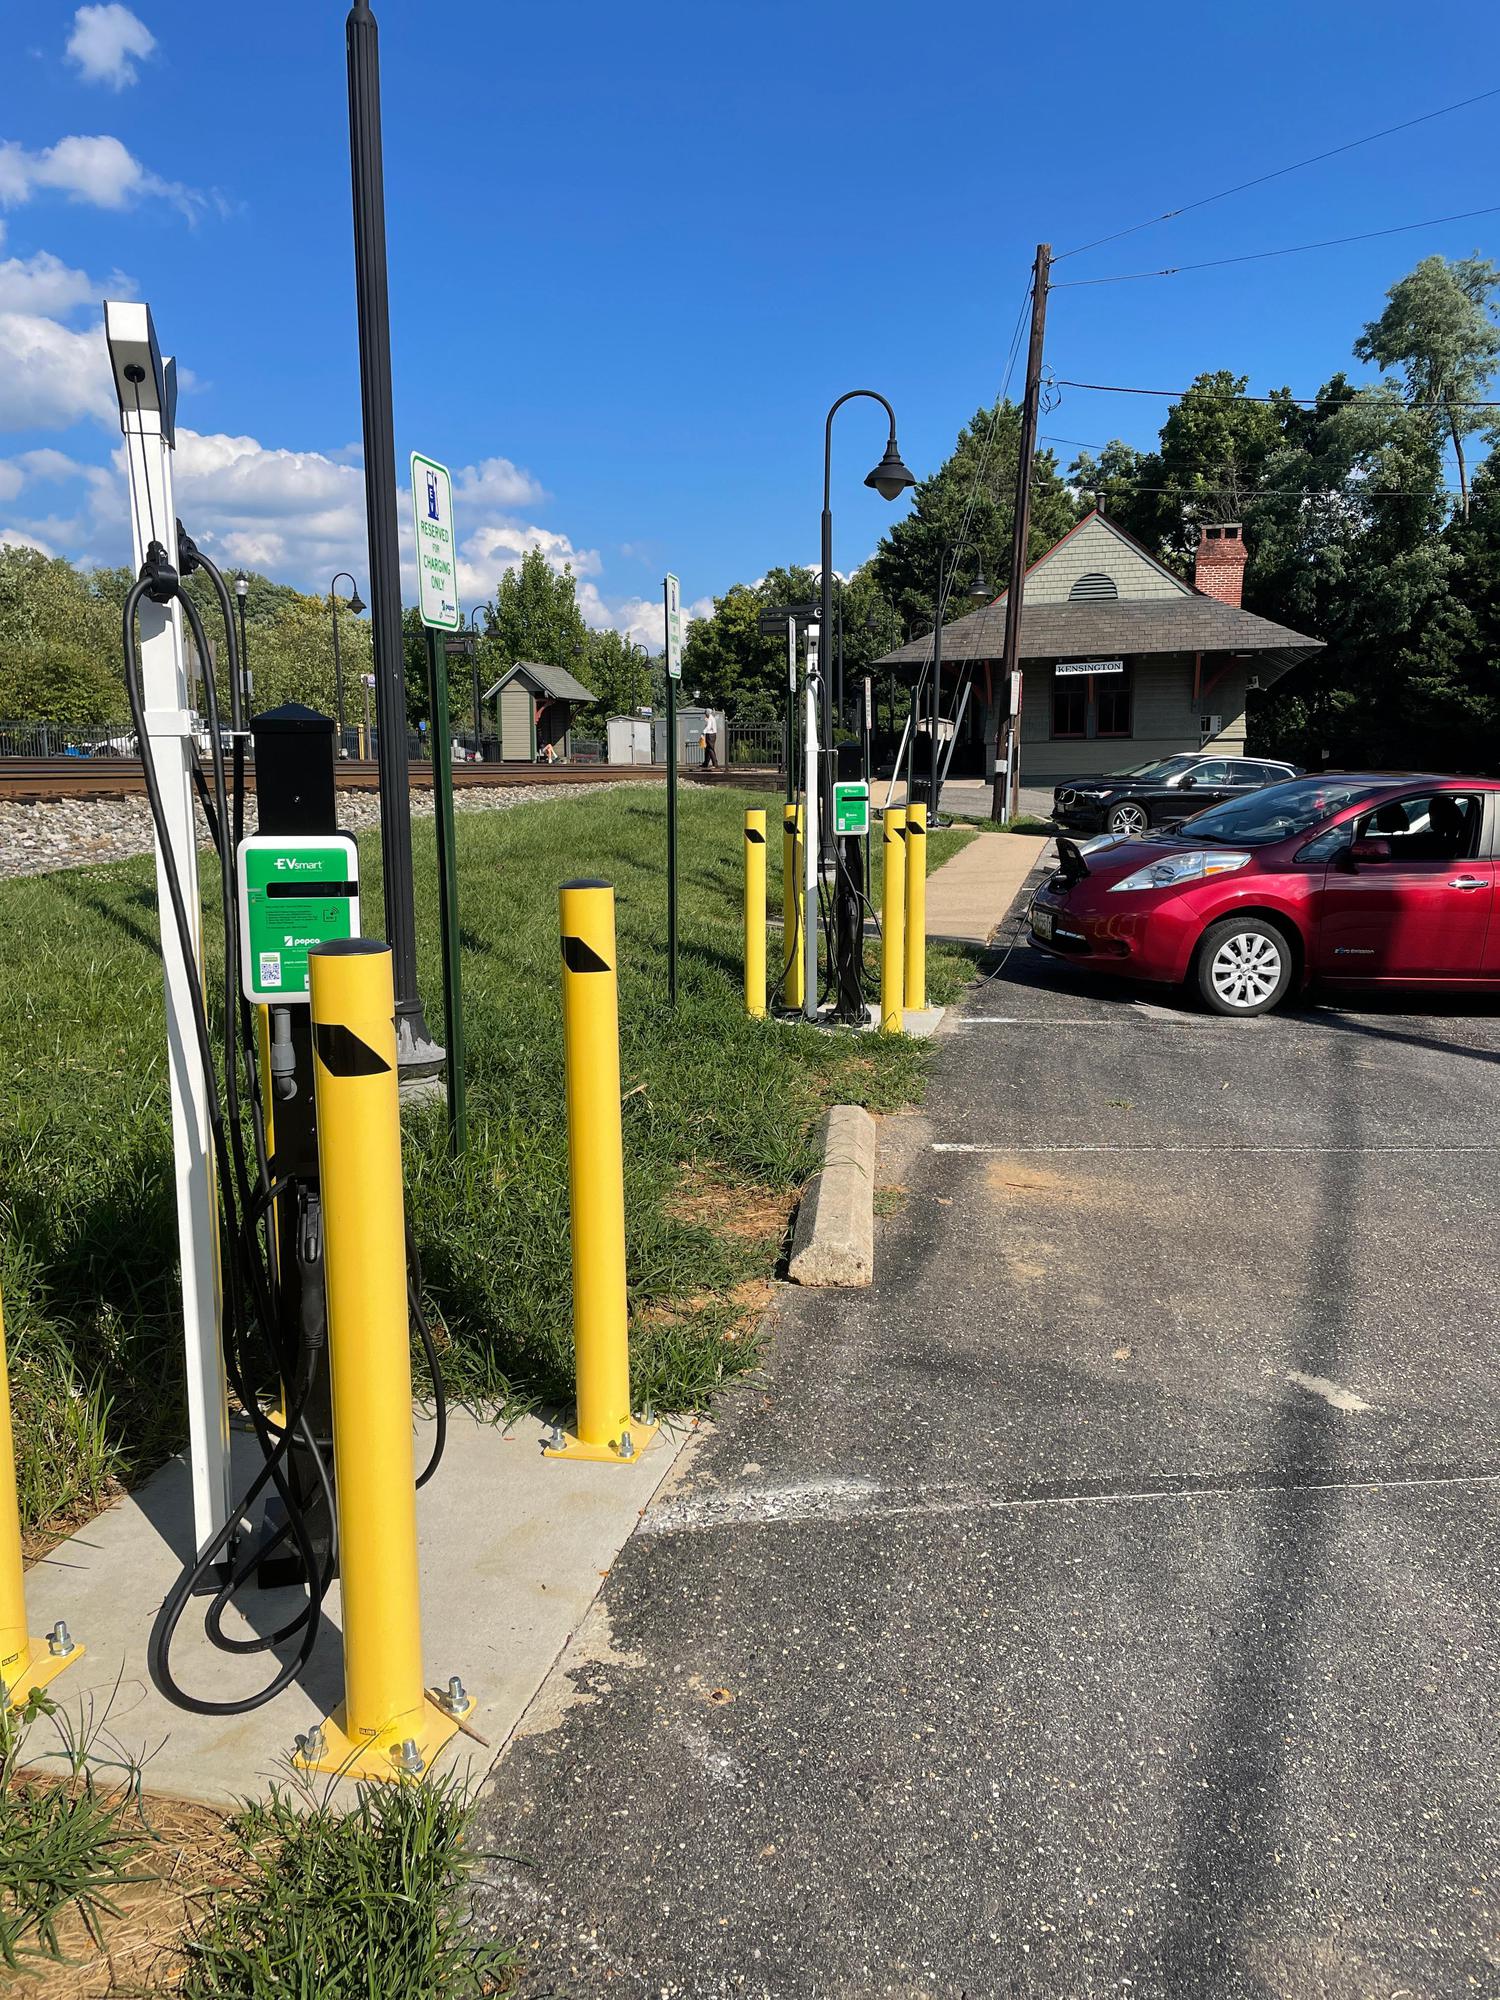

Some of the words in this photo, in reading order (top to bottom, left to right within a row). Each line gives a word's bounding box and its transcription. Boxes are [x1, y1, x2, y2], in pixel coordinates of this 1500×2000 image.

[420, 520, 449, 543] RESERVED
[424, 554, 451, 576] CHARGING
[431, 575, 445, 591] ONLY
[1057, 663, 1121, 673] KENSINGTON
[274, 858, 322, 870] EVsmart
[294, 938, 320, 946] pepco
